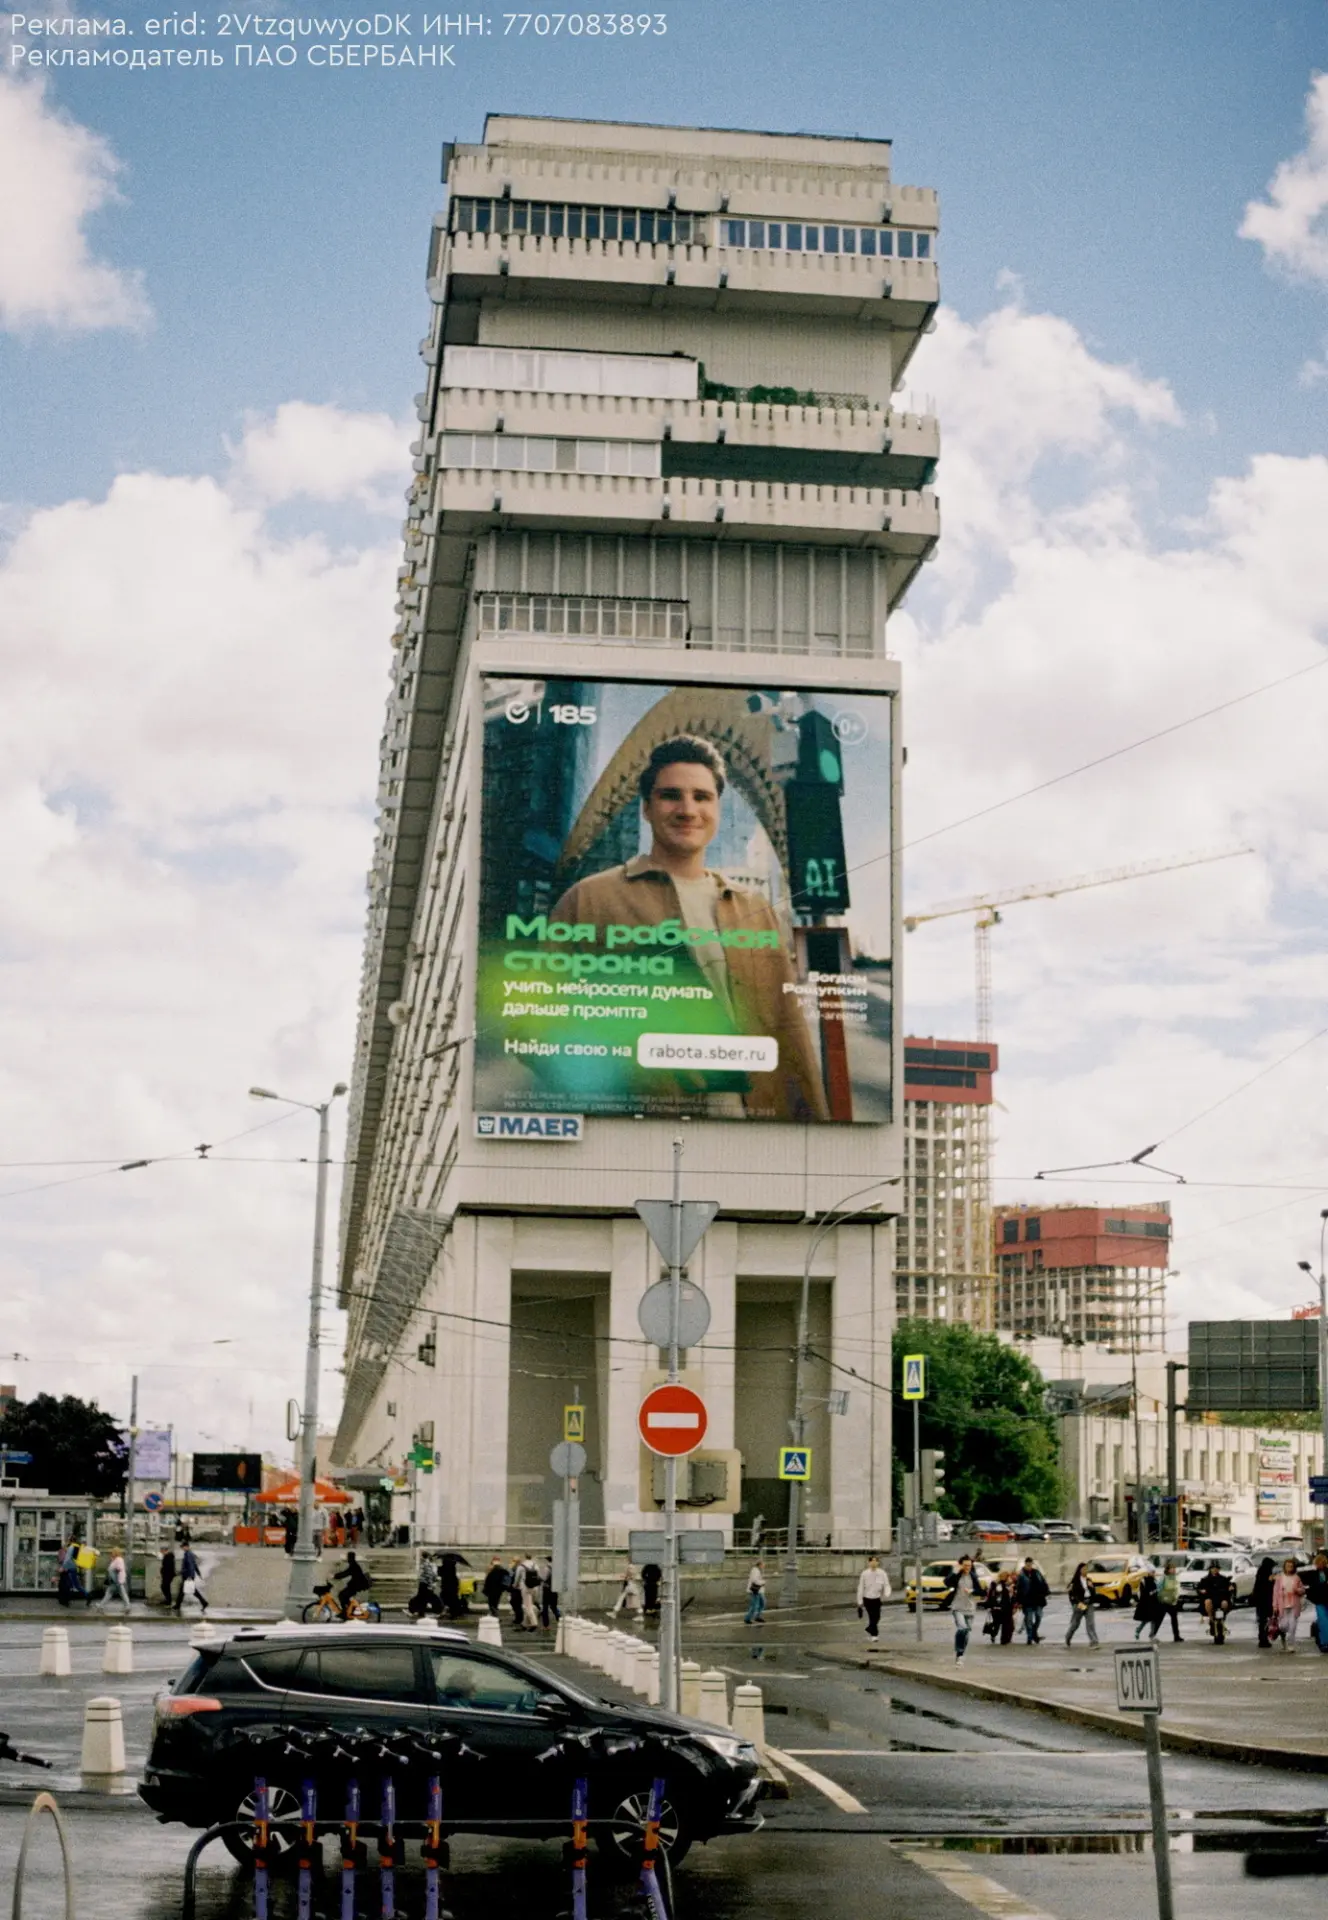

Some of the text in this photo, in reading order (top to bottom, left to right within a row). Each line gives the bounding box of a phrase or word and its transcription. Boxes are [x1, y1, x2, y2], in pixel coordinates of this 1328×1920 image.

[548, 704, 598, 725] 185
[506, 914, 597, 943] Моя
[504, 950, 674, 977] сторона
[808, 971, 867, 984] Богдан
[503, 978, 714, 1001] учить нейросети думать
[502, 1002, 648, 1020] дальше промпта
[504, 1038, 633, 1058] Найди свою на
[648, 1043, 766, 1062] rabota.sber.ru
[499, 1116, 579, 1136] MAER
[1120, 1659, 1154, 1701] СТОП
